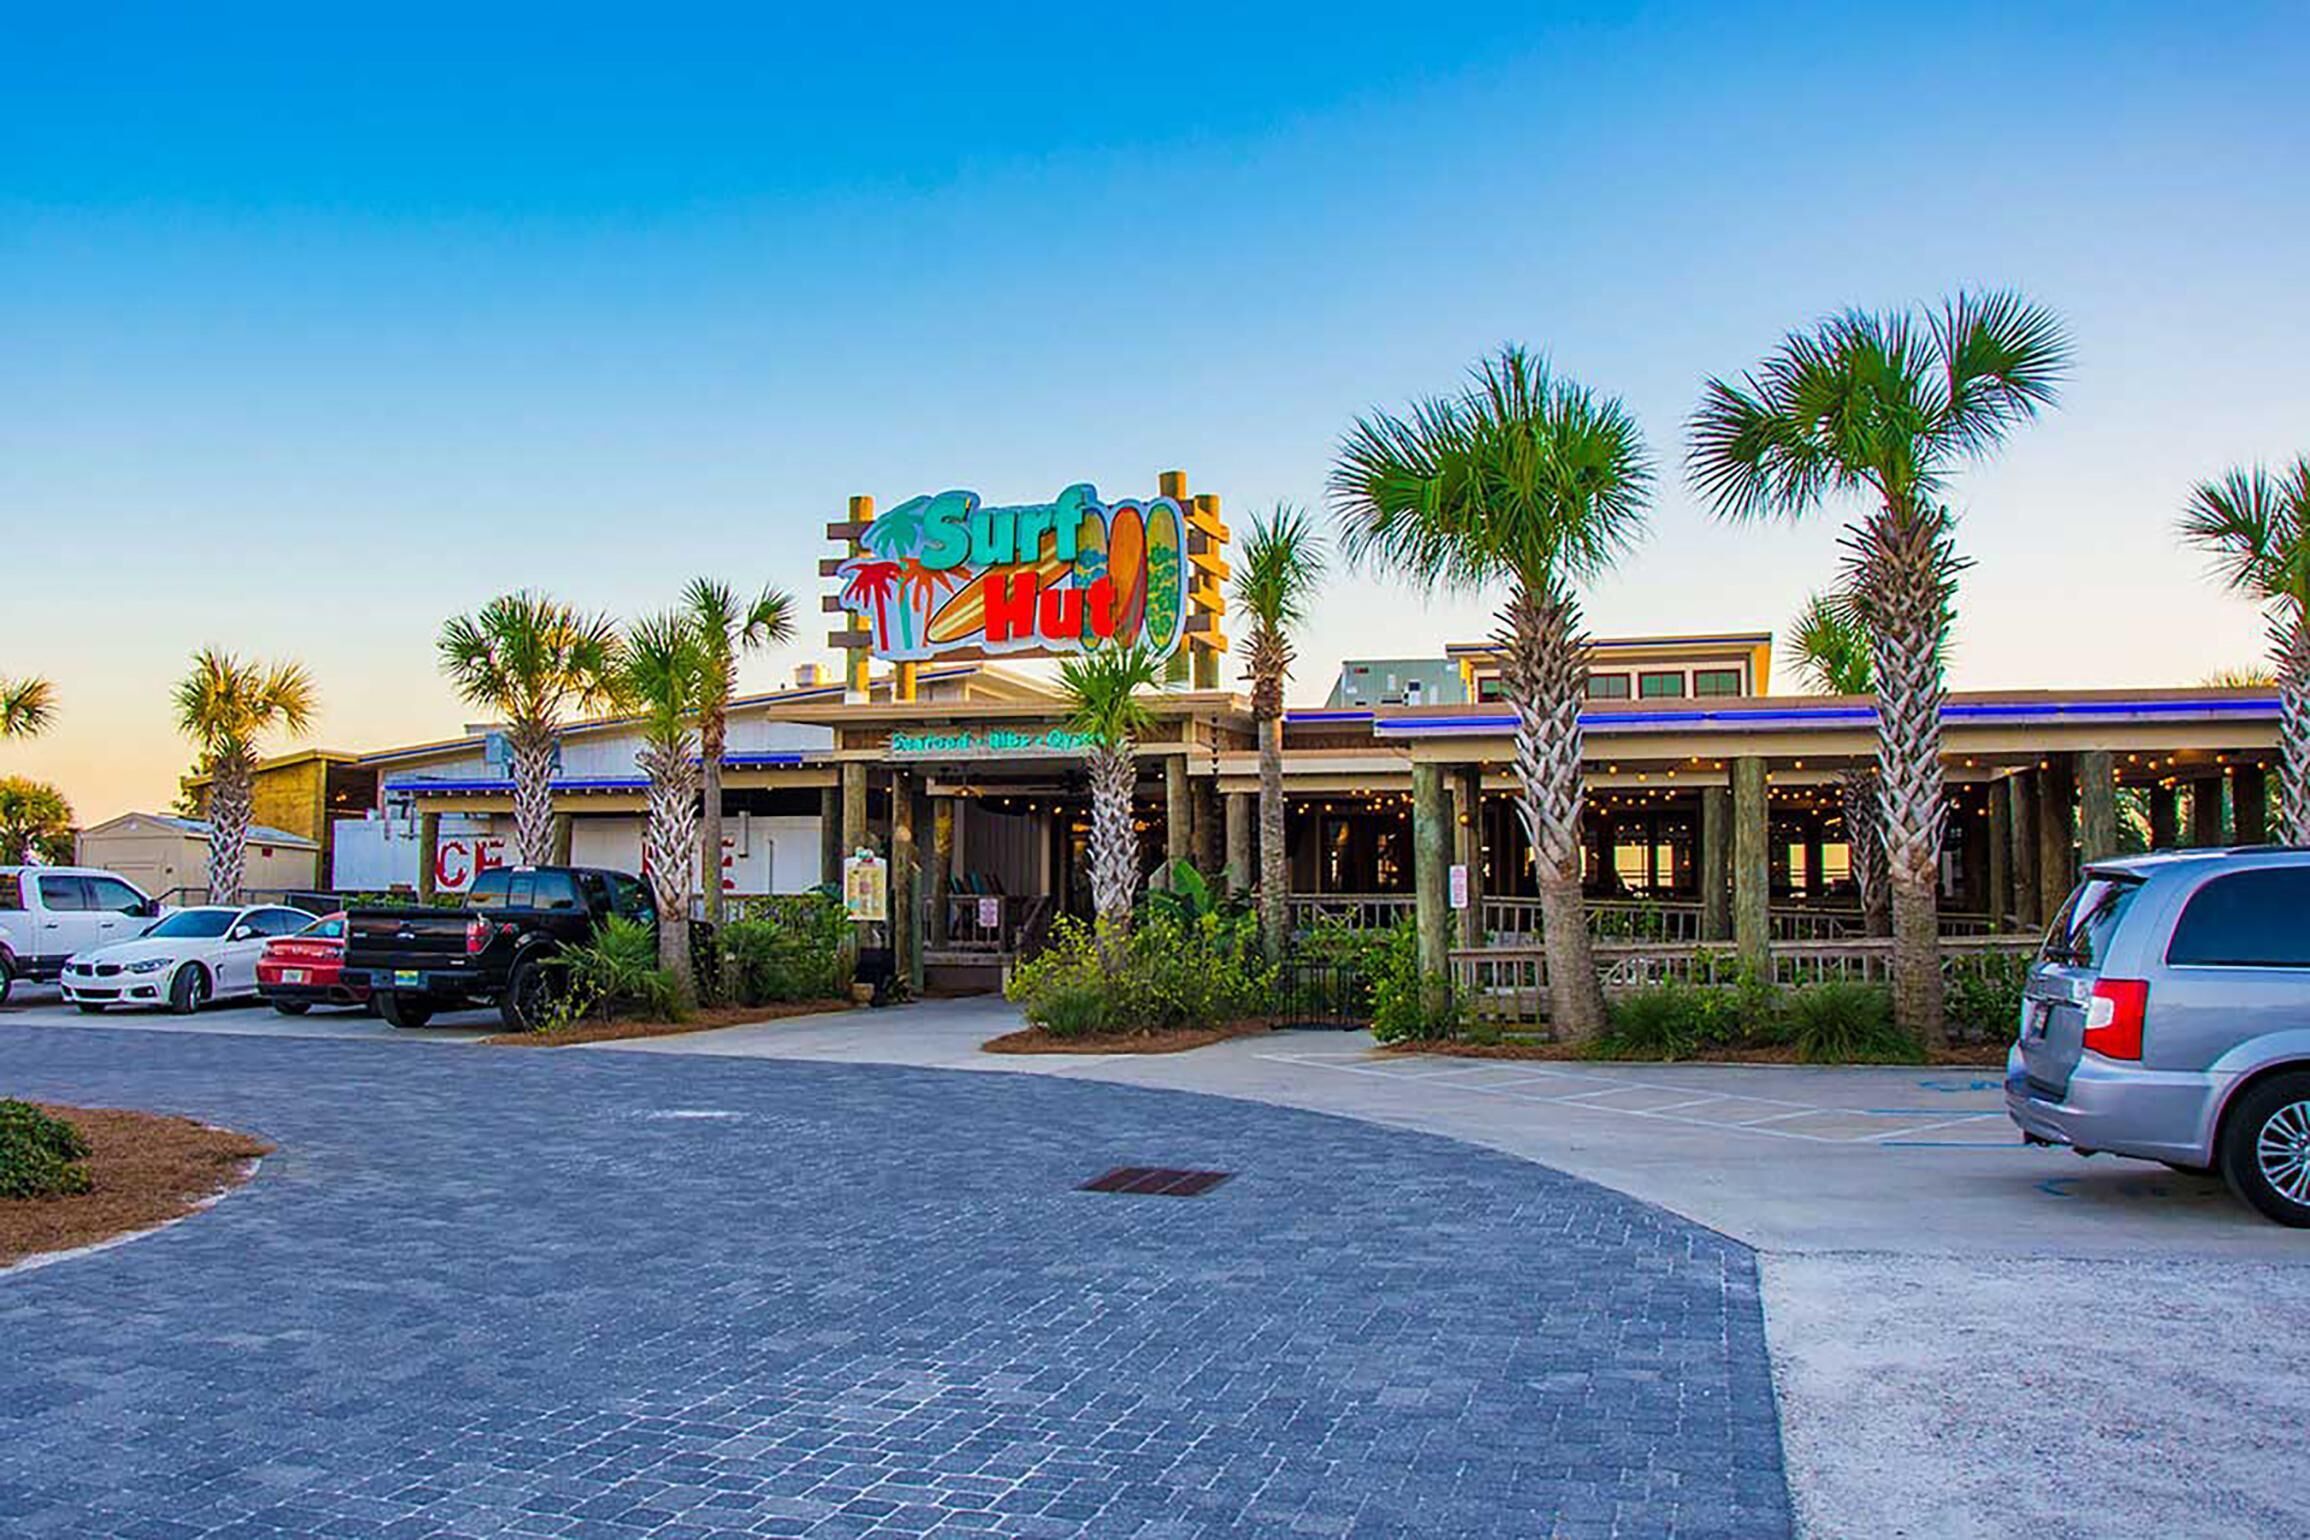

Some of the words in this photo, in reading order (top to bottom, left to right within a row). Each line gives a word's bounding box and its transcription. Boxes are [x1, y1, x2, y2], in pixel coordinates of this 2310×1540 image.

[919, 484, 1084, 570] Surf
[983, 571, 1116, 642] Hut
[892, 730, 971, 752] Seafood
